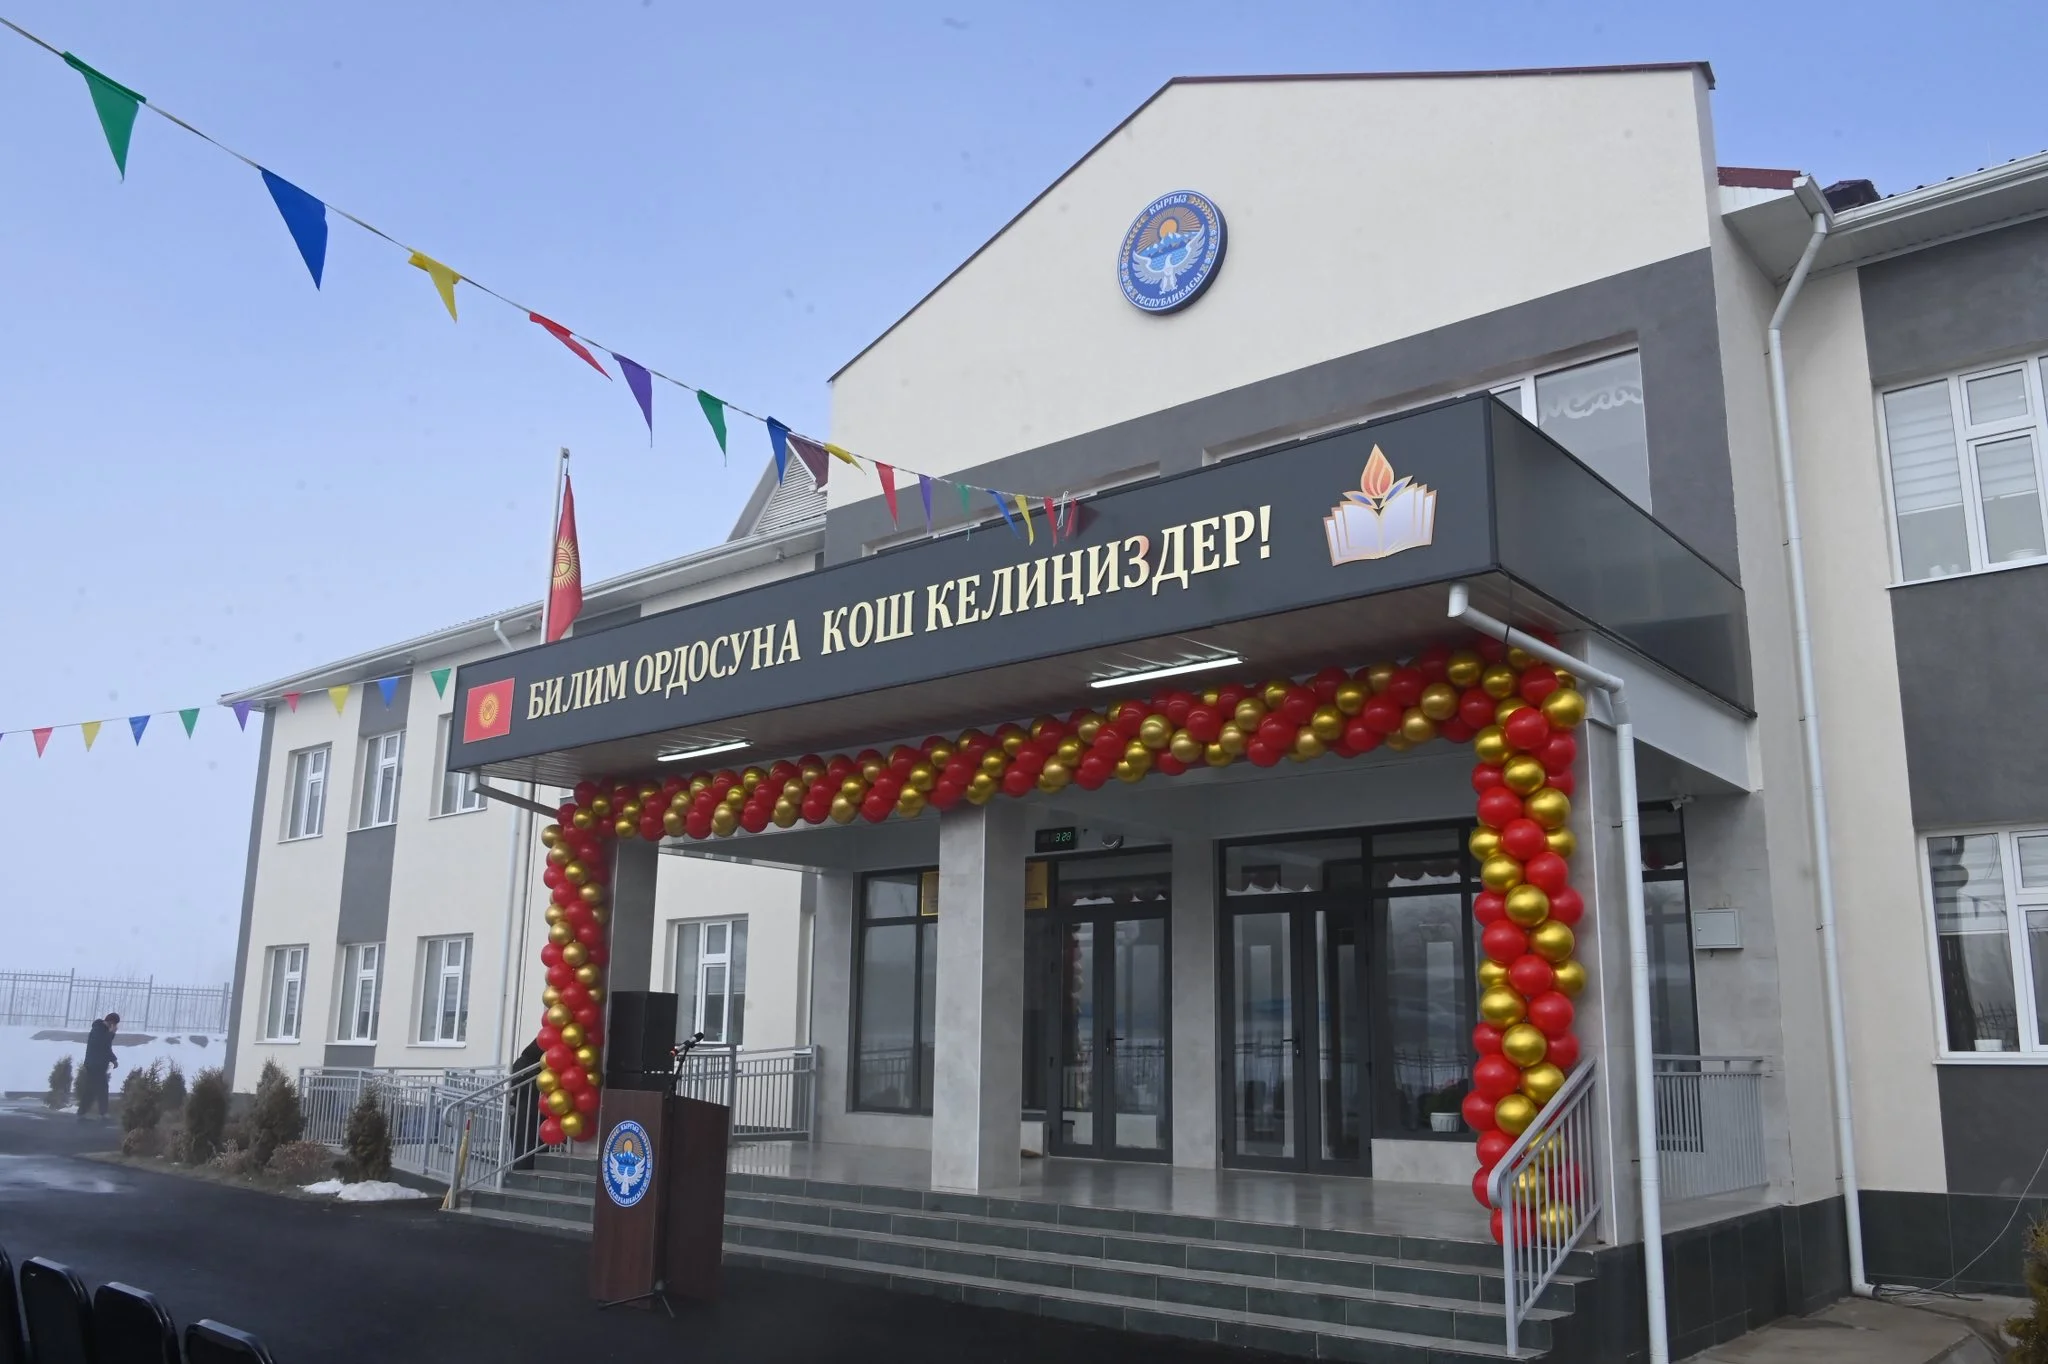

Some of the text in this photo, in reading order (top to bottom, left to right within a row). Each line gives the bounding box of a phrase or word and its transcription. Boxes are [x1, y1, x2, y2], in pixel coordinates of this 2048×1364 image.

[1149, 194, 1187, 215] КЫРГЫЗ
[1135, 273, 1203, 307] РЕСПУБЛИКАСЫ
[527, 505, 1273, 720] БИЛИМ ОРДОСУНА КОШ КЕЛИҢИЗДЕР!
